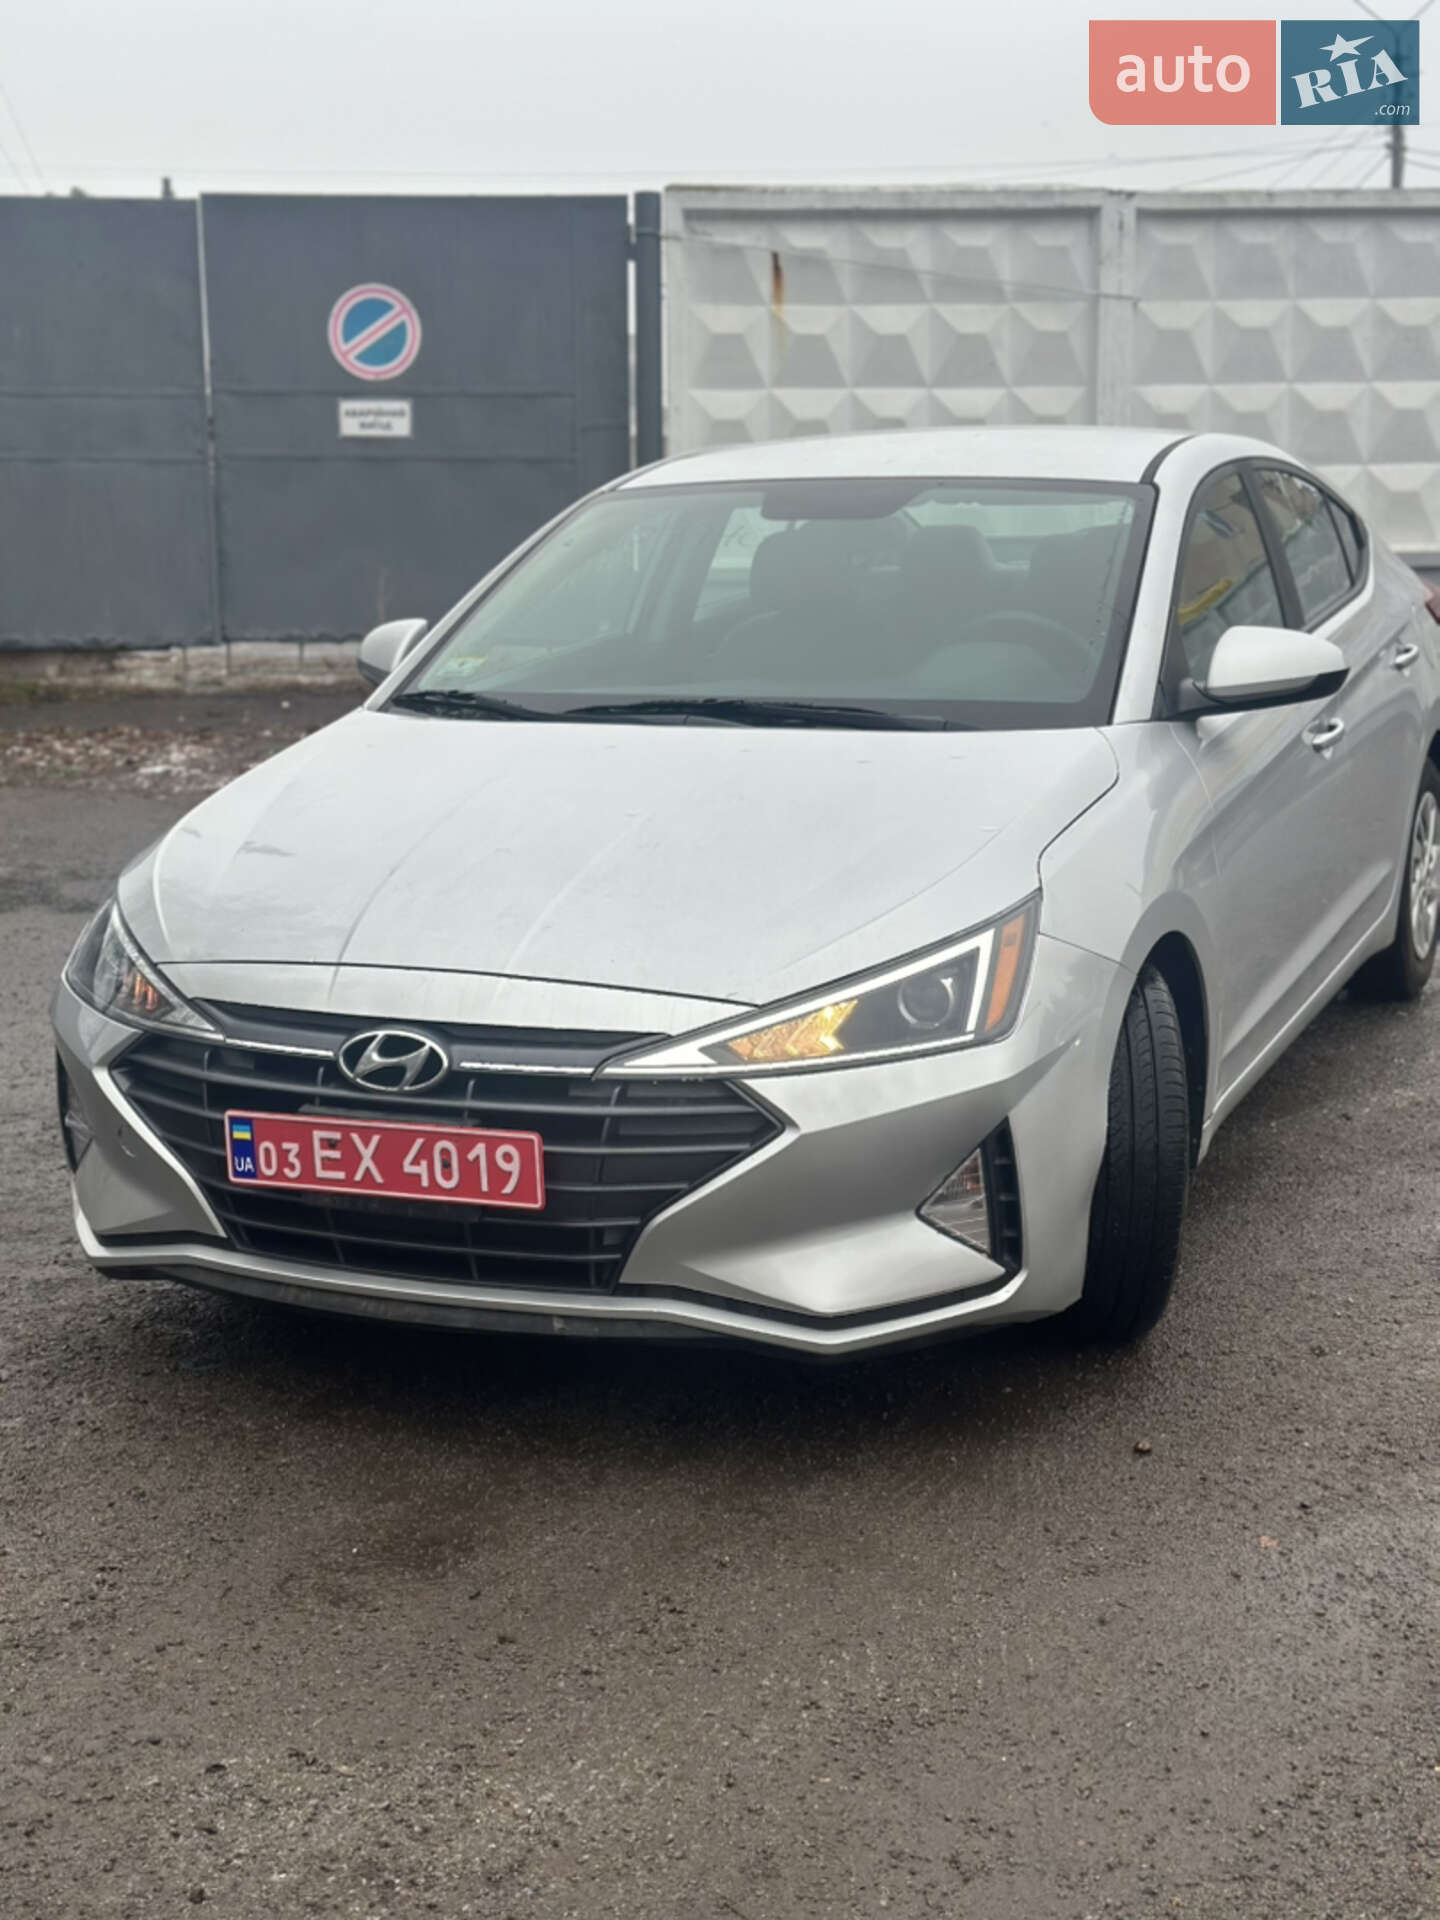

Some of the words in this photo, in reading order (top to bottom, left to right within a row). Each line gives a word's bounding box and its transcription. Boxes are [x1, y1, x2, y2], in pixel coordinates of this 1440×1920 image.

[234, 1156, 255, 1173] UA
[258, 1141, 302, 1179] 03
[312, 1130, 384, 1184] EX
[402, 1138, 520, 1194] 4019
